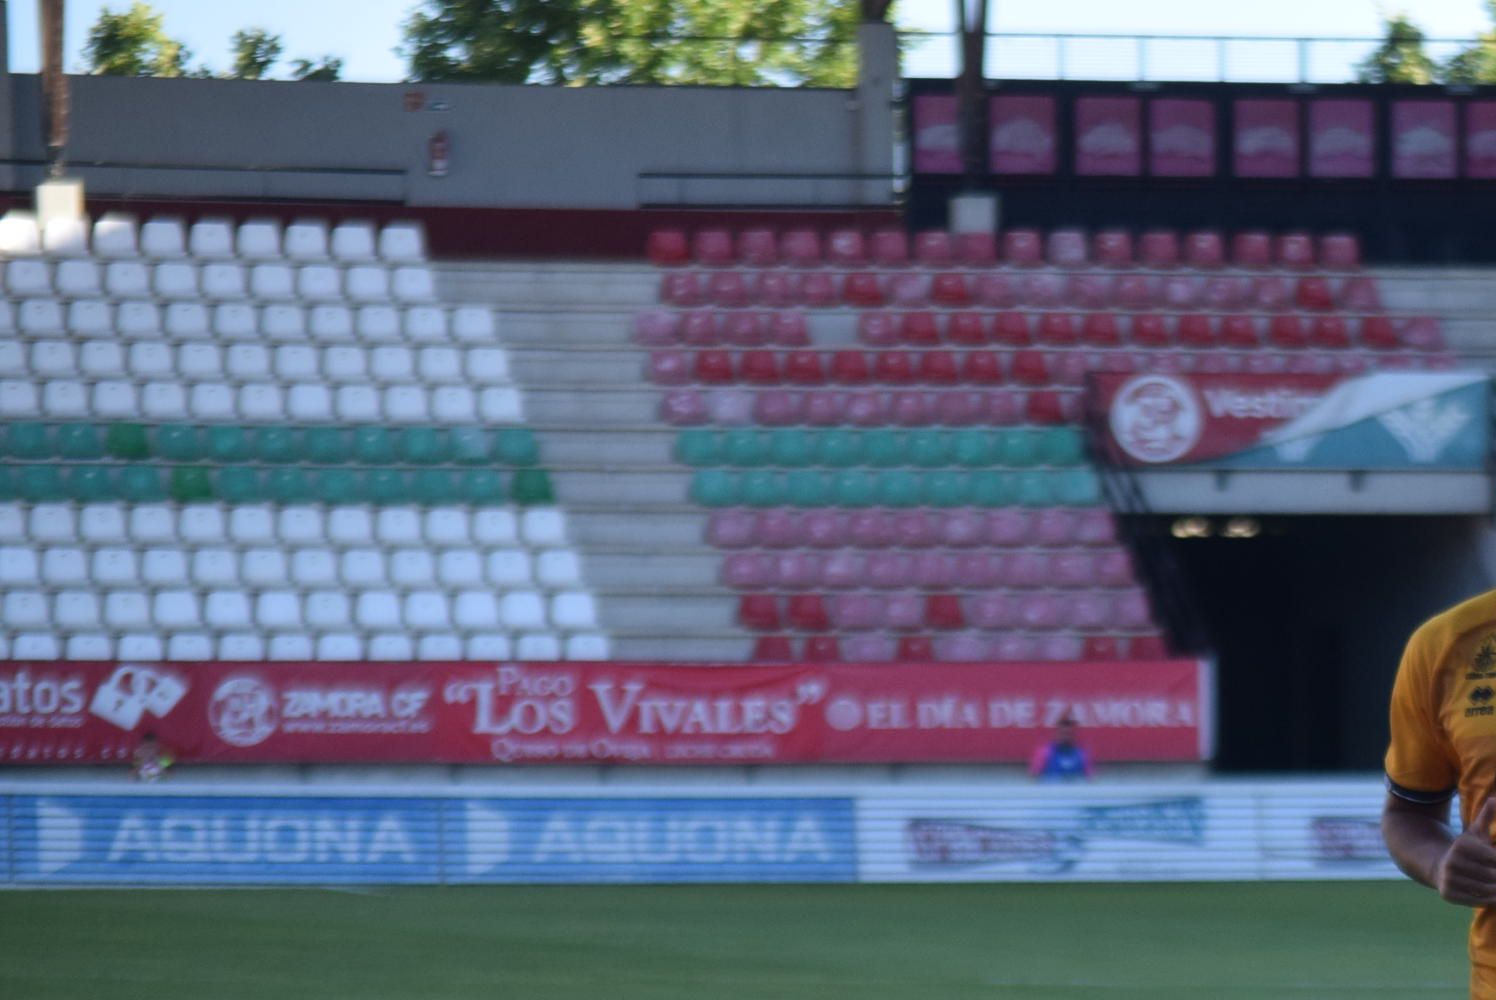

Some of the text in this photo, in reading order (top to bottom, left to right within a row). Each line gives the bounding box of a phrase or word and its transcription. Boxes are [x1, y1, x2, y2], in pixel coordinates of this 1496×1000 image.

[866, 702, 912, 729] EL
[988, 701, 1041, 729] DE
[1044, 699, 1196, 728] ZAMORA
[107, 812, 414, 863] AQUONA
[532, 811, 831, 863] AQUONA
